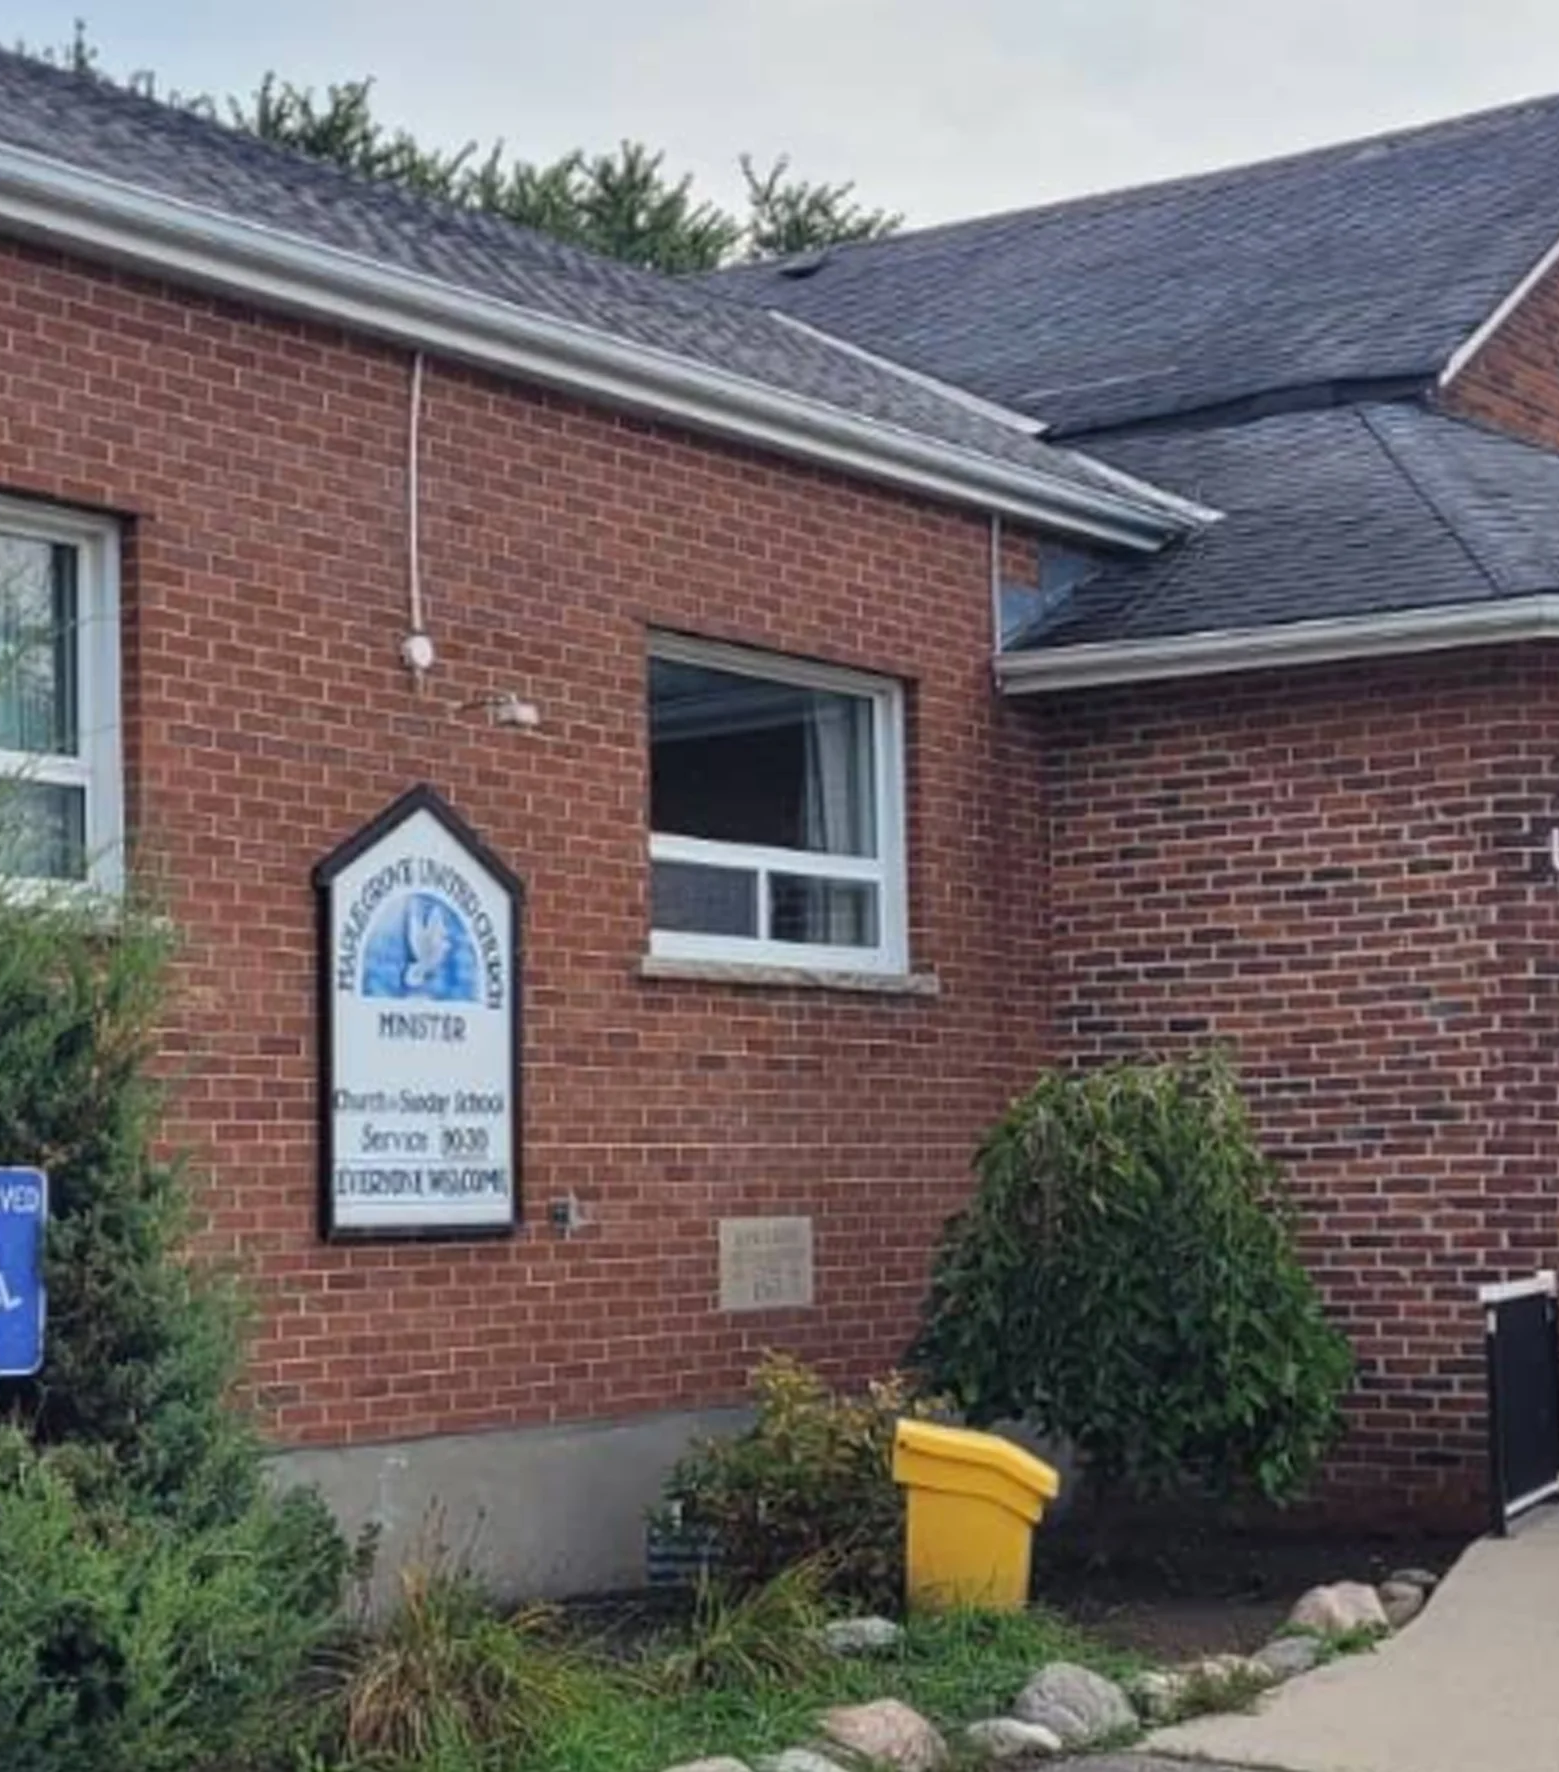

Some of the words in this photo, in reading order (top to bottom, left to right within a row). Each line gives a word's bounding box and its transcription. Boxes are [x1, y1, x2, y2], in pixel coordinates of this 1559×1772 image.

[377, 1011, 467, 1042] MINISTER
[453, 1090, 505, 1114] School
[361, 1123, 429, 1153] Service
